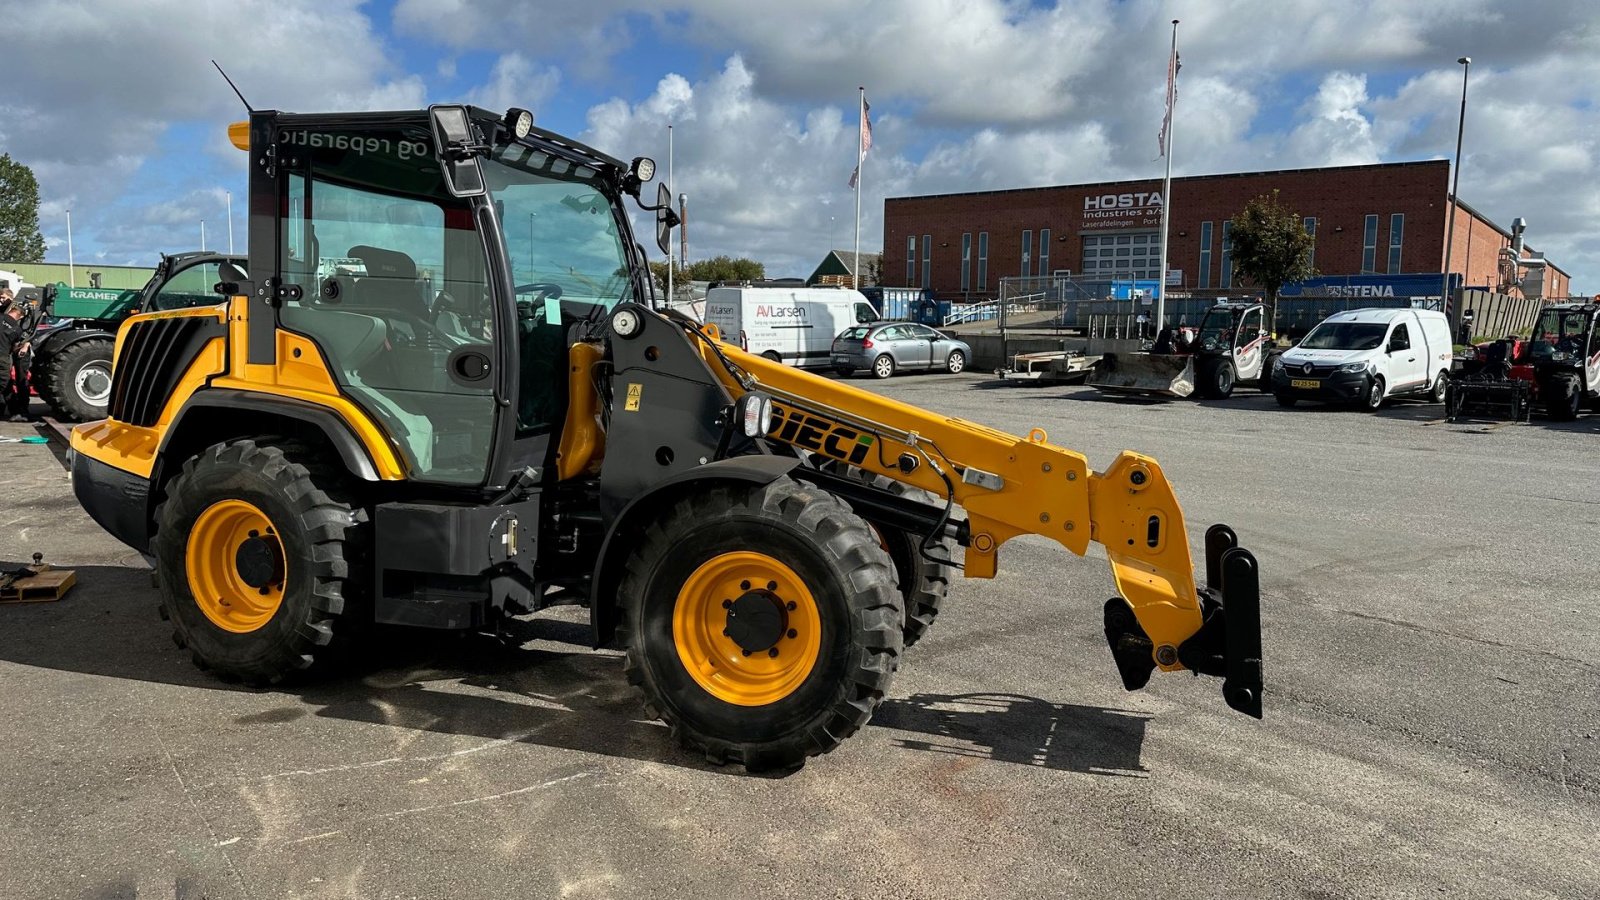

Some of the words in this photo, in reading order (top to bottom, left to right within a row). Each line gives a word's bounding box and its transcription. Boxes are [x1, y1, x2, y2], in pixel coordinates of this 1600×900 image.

[1084, 192, 1163, 210] HOSTA
[1084, 209, 1142, 218] industries
[70, 290, 119, 300] KRAMER
[1343, 285, 1394, 297] STENA
